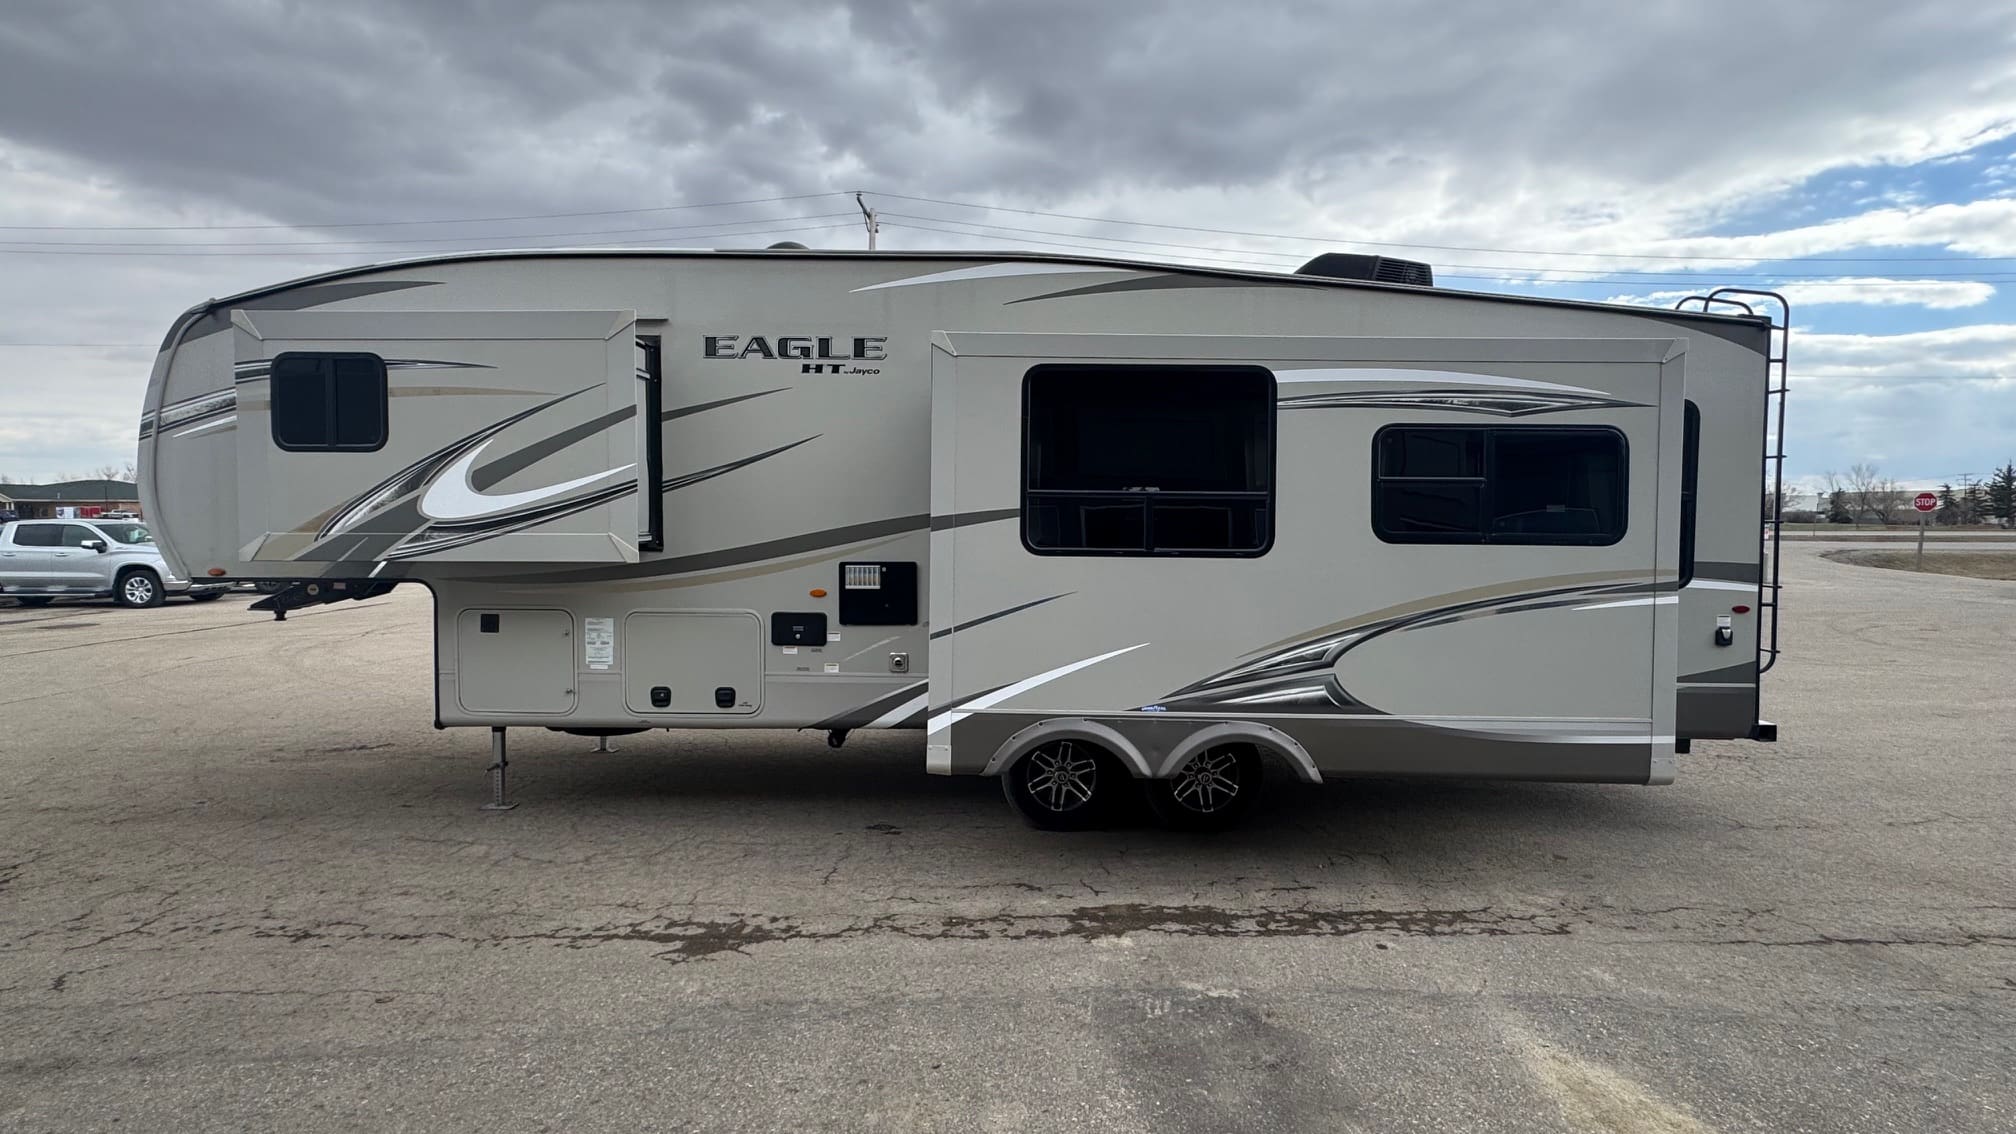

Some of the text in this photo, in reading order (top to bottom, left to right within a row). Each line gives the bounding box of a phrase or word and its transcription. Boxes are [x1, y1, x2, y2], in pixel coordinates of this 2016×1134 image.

[703, 335, 888, 360] EAGLE
[801, 364, 880, 375] HT Jayco
[1915, 498, 1936, 506] STOP
